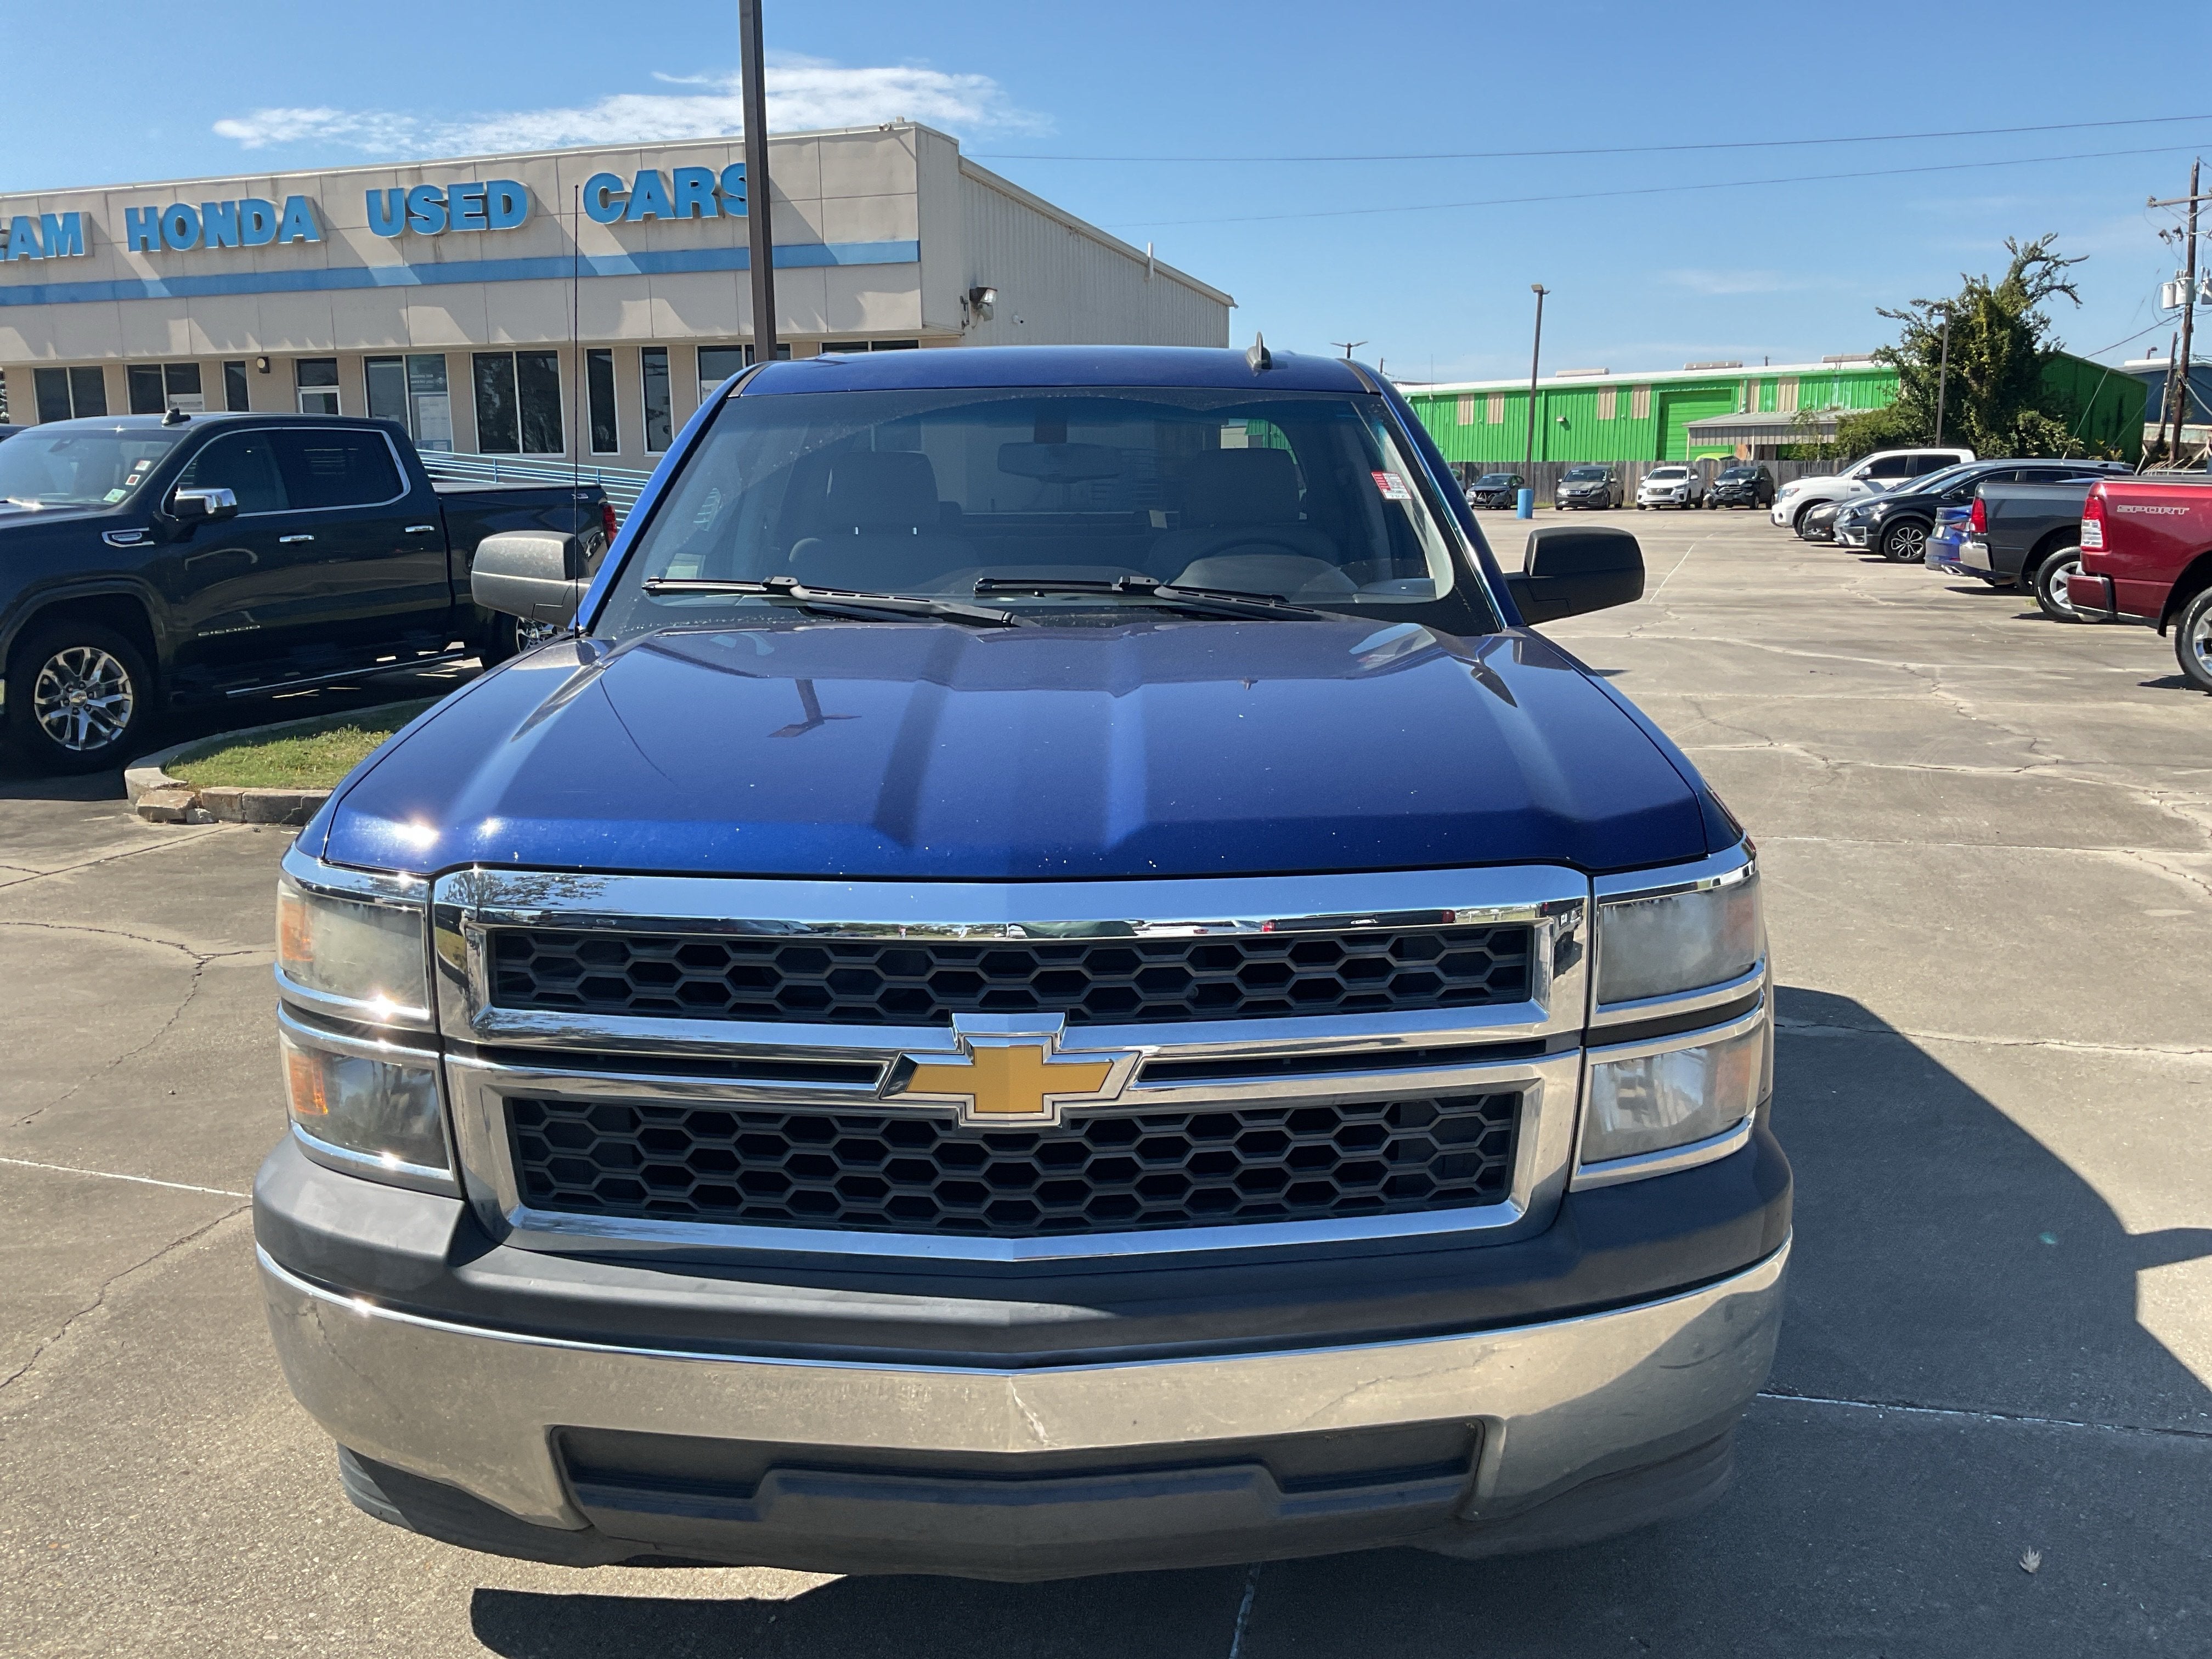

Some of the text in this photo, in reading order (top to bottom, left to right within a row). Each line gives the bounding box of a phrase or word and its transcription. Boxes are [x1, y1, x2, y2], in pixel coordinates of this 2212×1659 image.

[0, 162, 748, 262] AM HONDA USED CARS
[2117, 505, 2190, 515] SPORT
